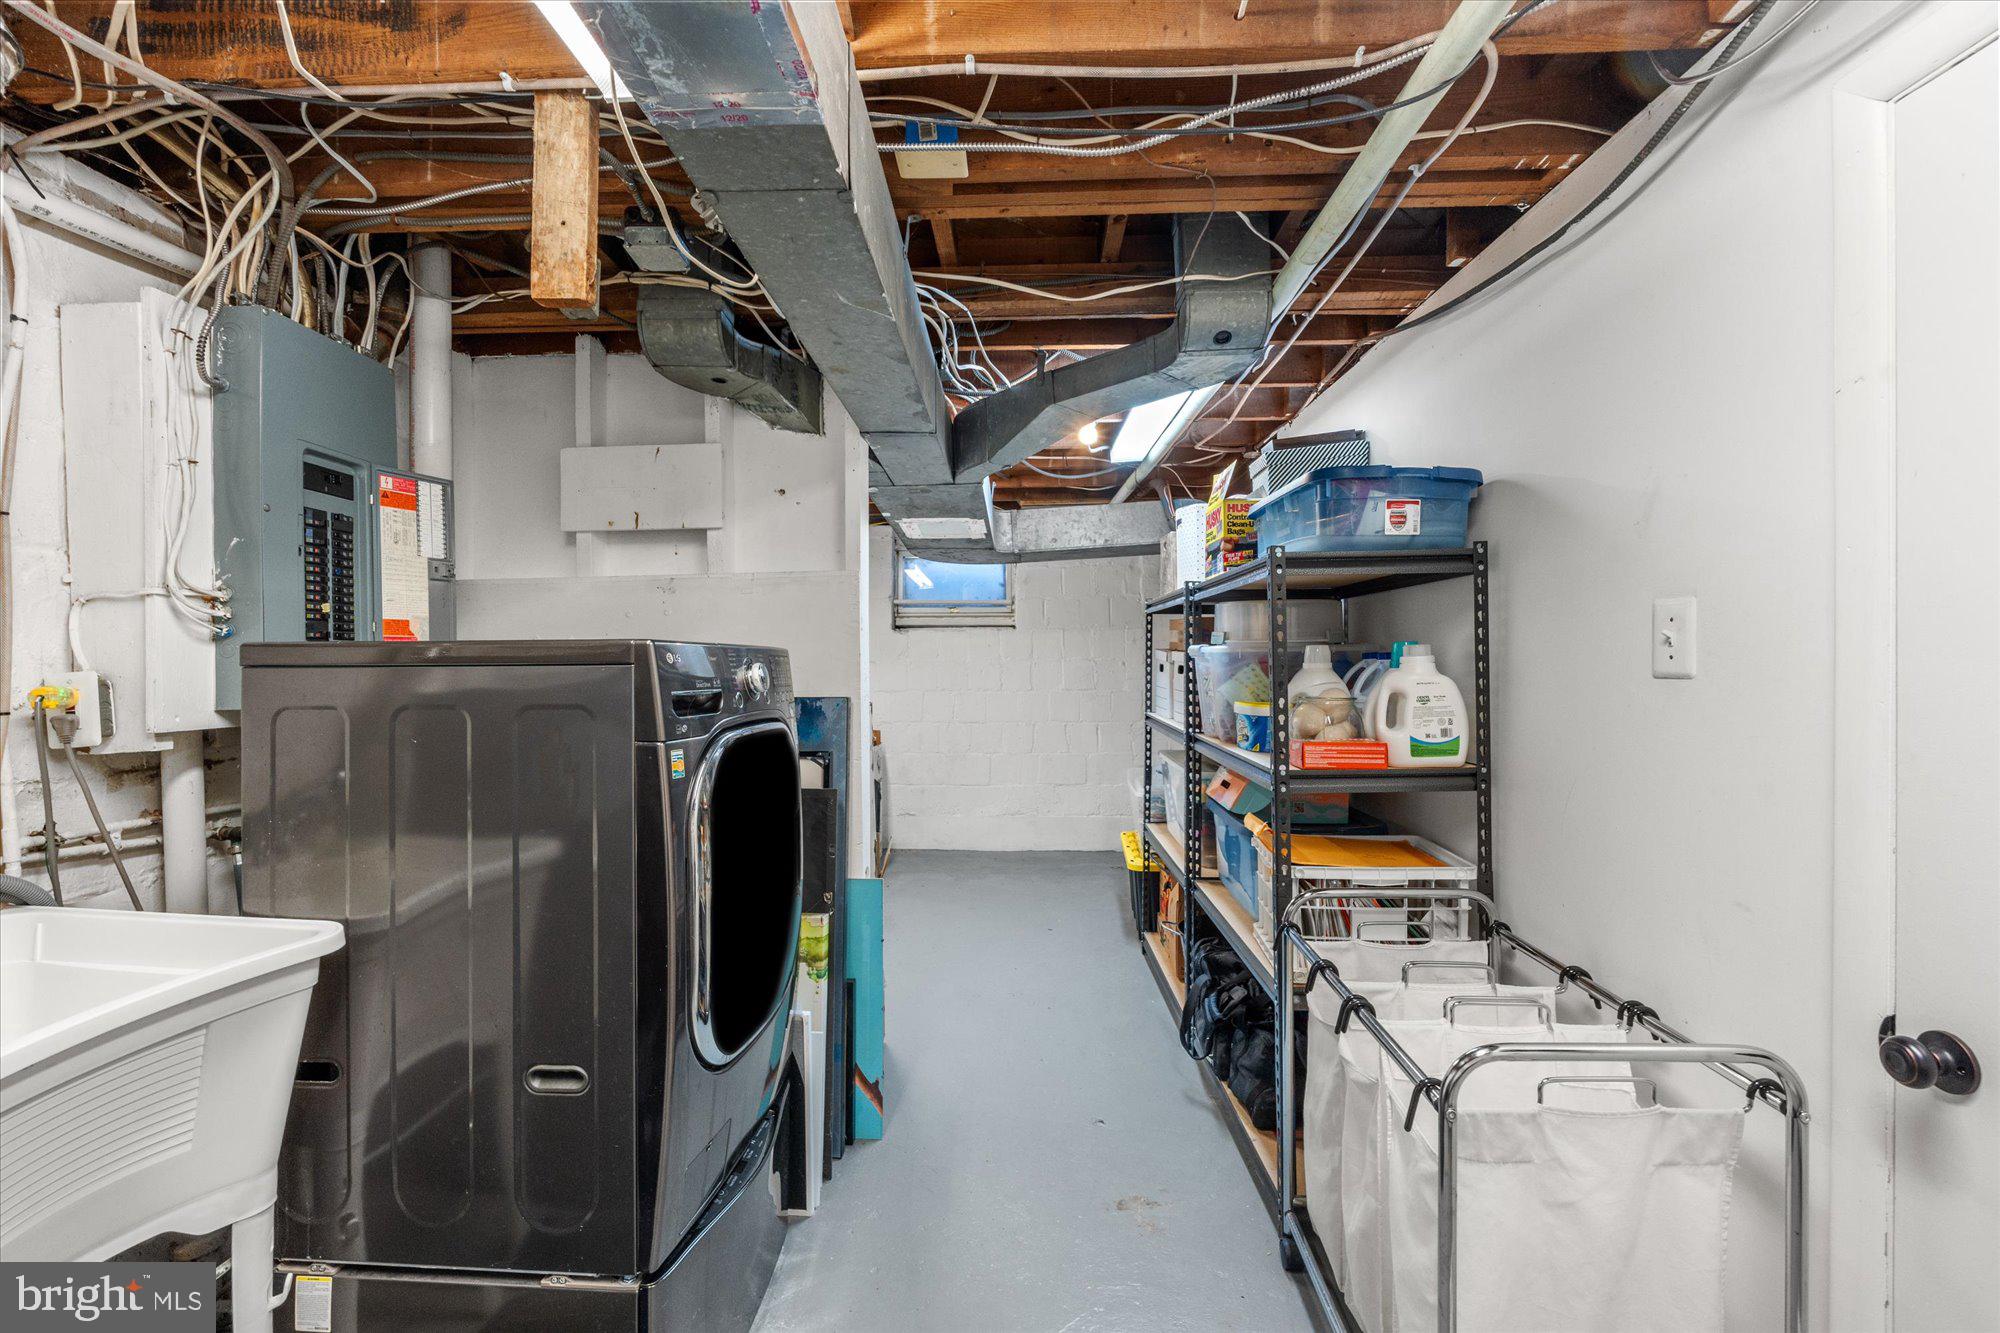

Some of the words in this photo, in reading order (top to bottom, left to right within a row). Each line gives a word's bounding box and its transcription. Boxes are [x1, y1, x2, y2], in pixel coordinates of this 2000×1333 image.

[721, 114, 750, 122] 12/20
[1227, 503, 1252, 513] HUS
[1227, 513, 1248, 521] Contr
[1227, 520, 1255, 528] Clean-U
[1227, 527, 1246, 536] Bags
